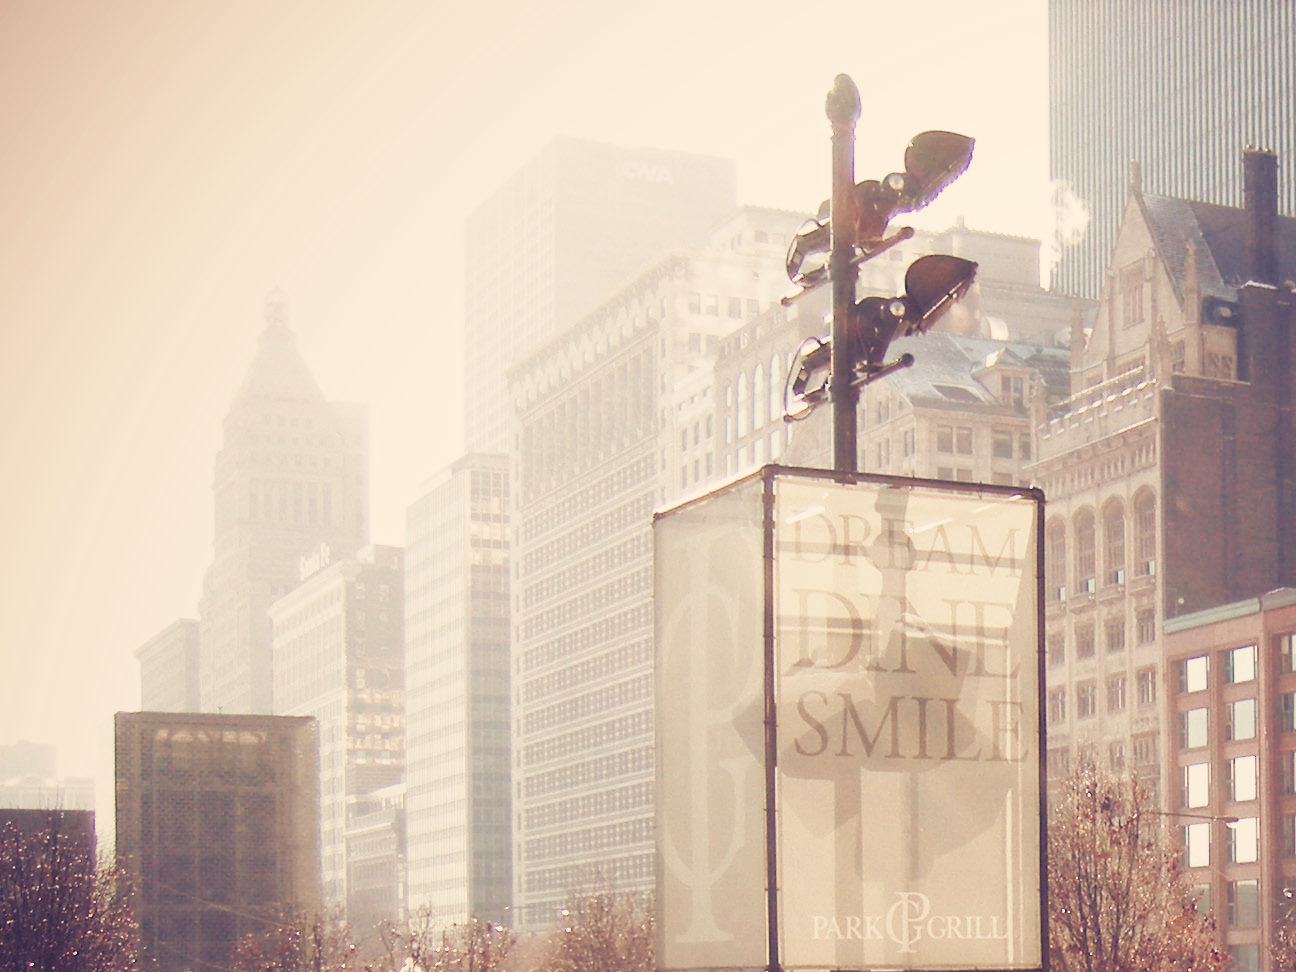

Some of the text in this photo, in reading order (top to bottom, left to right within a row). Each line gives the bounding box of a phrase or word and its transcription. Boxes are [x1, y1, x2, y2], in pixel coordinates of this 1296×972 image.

[791, 512, 1022, 579] DREAM
[789, 587, 1021, 679] DINE
[795, 690, 1029, 762] SMILE
[811, 915, 884, 940] PARK
[927, 915, 1009, 940] GRILL
